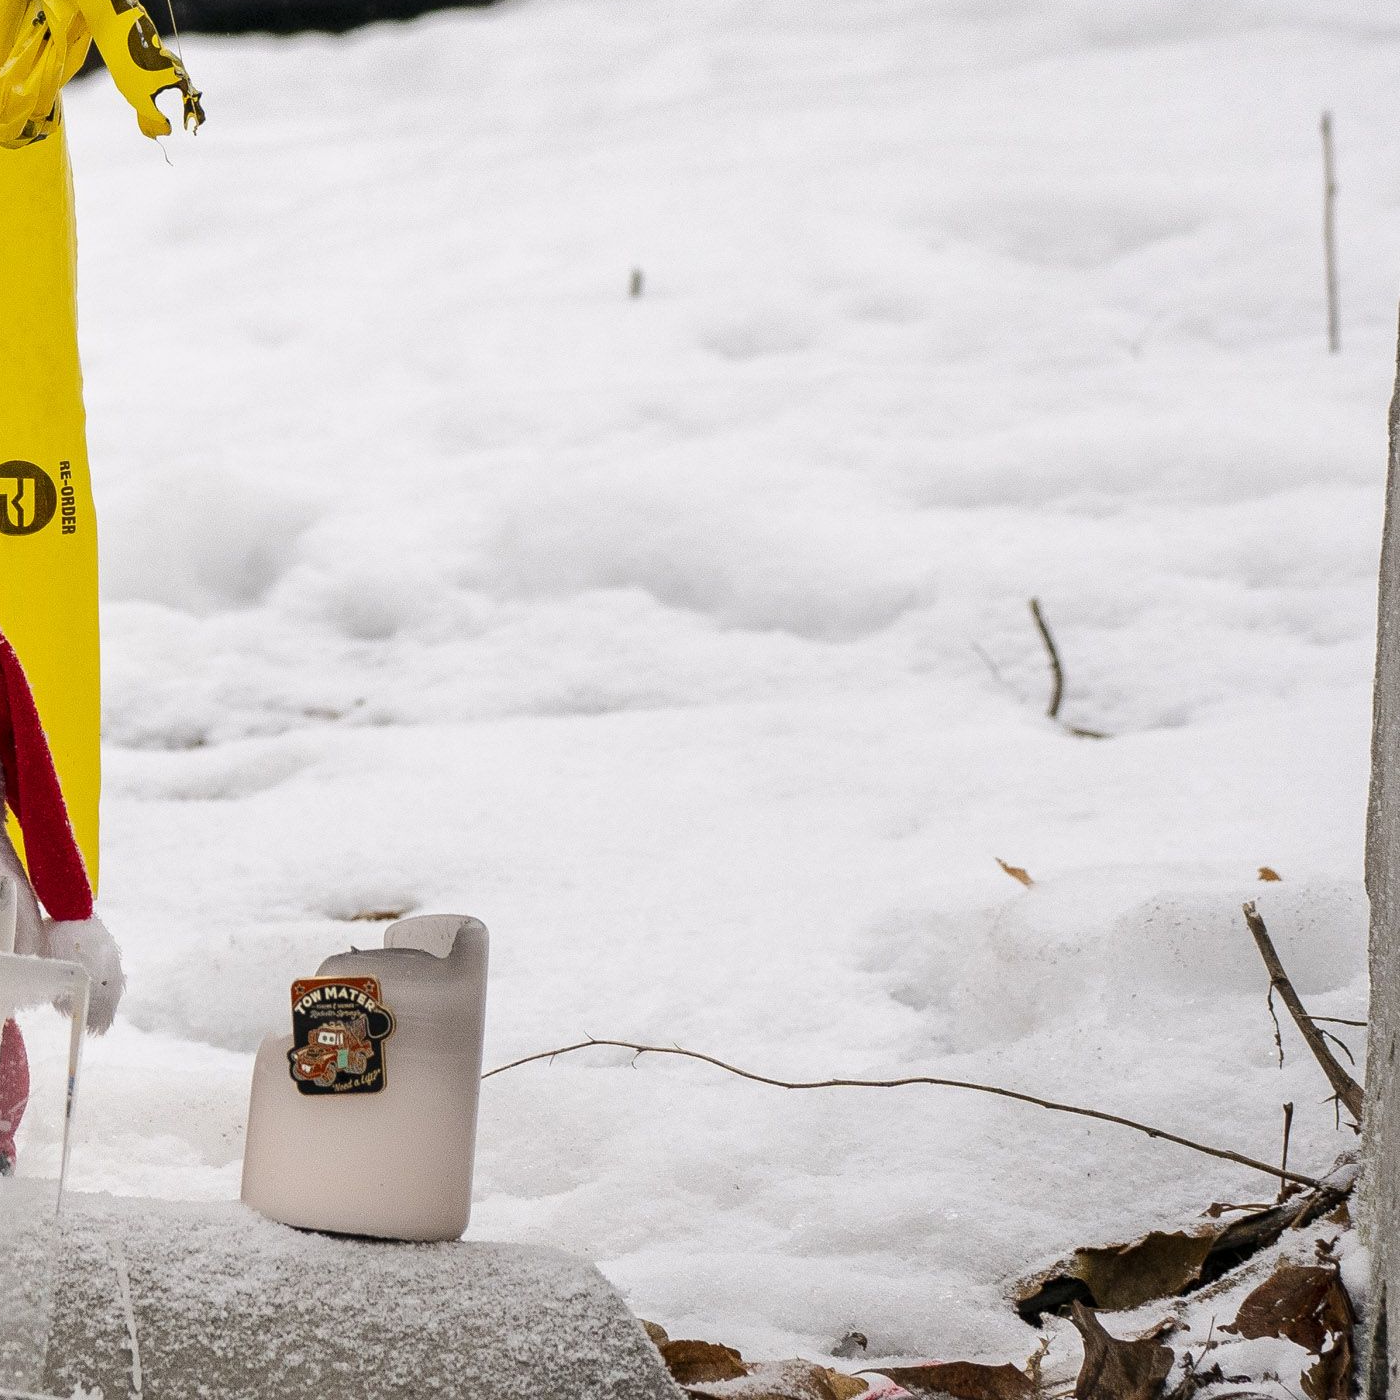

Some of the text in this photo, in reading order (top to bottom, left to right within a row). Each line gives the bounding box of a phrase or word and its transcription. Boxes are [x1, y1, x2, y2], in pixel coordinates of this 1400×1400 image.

[59, 460, 76, 535] RE-ORDER
[294, 986, 376, 1015] TOW MATER
